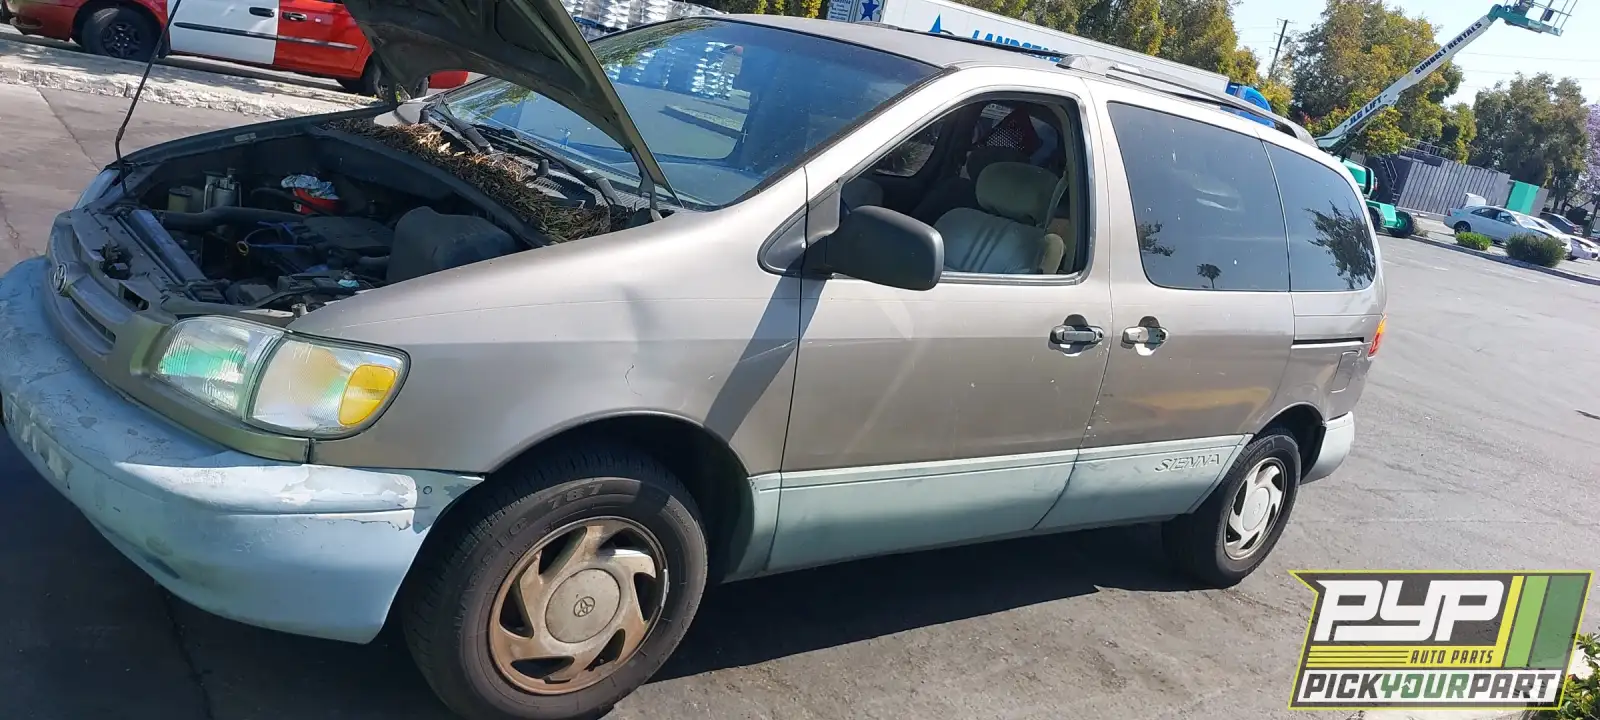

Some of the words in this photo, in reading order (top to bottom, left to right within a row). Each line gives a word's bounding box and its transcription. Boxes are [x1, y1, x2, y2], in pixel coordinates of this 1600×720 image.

[1415, 48, 1446, 75] SUNBELT
[1447, 21, 1482, 50] RENTALS
[1365, 96, 1382, 113] LIFT
[1154, 453, 1220, 472] SIENNA
